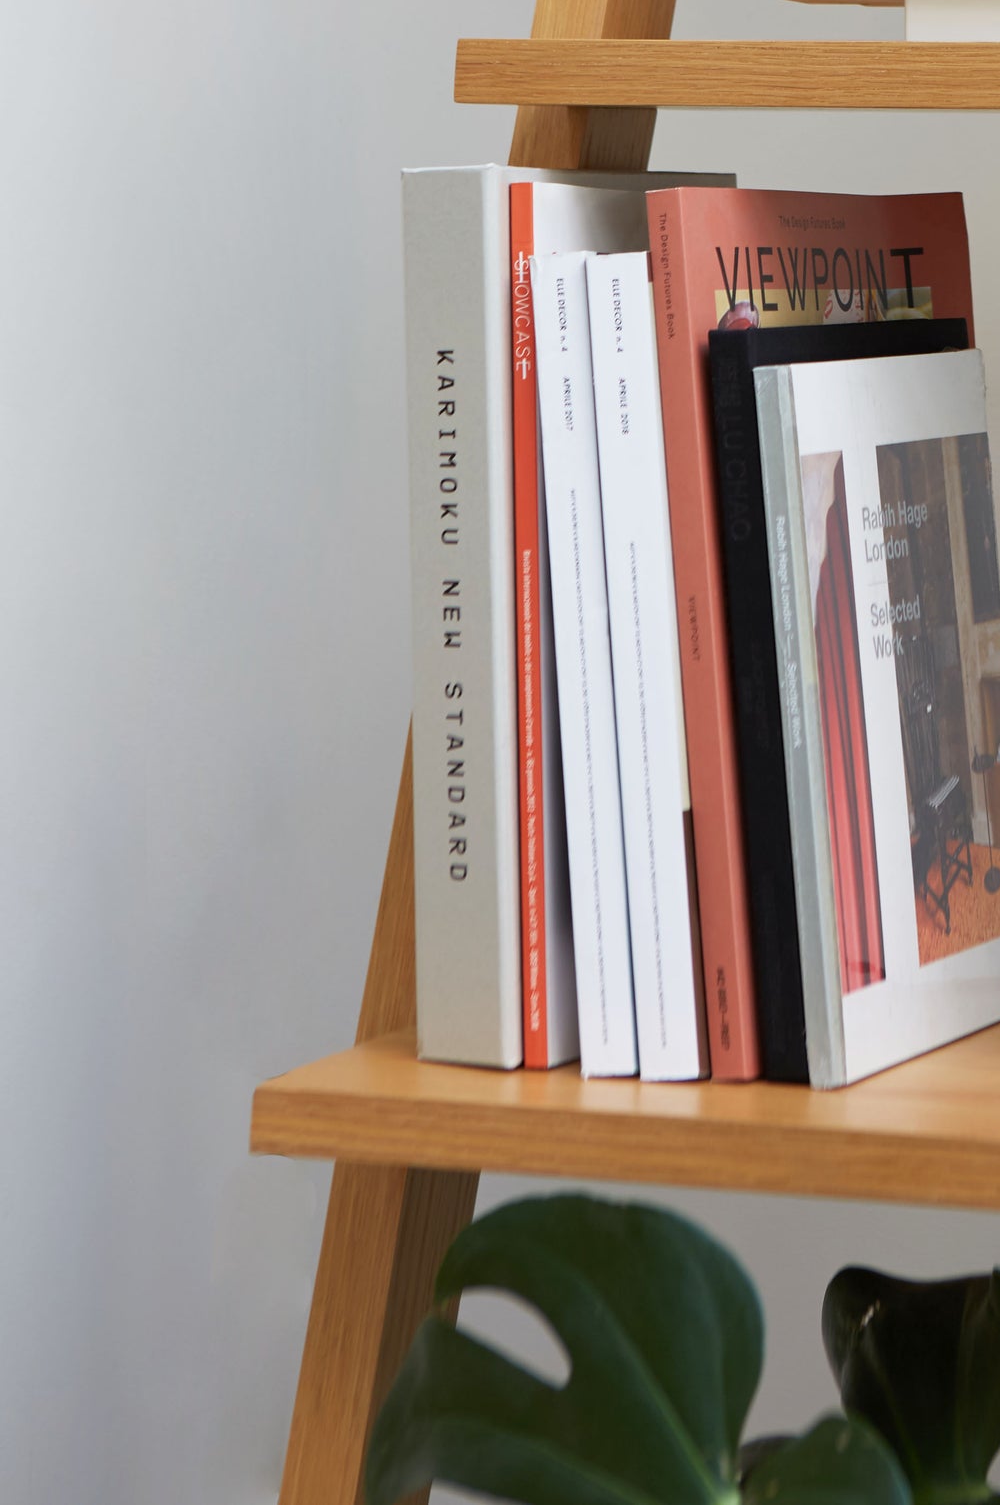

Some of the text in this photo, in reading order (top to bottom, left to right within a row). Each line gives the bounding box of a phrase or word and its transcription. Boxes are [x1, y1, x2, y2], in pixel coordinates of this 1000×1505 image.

[661, 235, 669, 269] Design
[556, 278, 565, 297] ELLE
[612, 278, 620, 298] ELLE
[663, 272, 672, 310] Futures
[715, 246, 924, 312] VIEWPOINT
[514, 252, 531, 380] SHOWCASE
[558, 299, 567, 331] DECOR
[614, 300, 623, 332] DECOR
[666, 313, 675, 340] Book
[563, 376, 574, 432] APRILE 2017
[618, 377, 629, 435] APRILE 2018
[862, 500, 929, 532] Rabih Hage
[864, 535, 909, 563] London
[436, 349, 468, 882] KARIMOKU NEW STANDARD
[870, 595, 921, 627] Selected
[873, 633, 905, 660] Work
